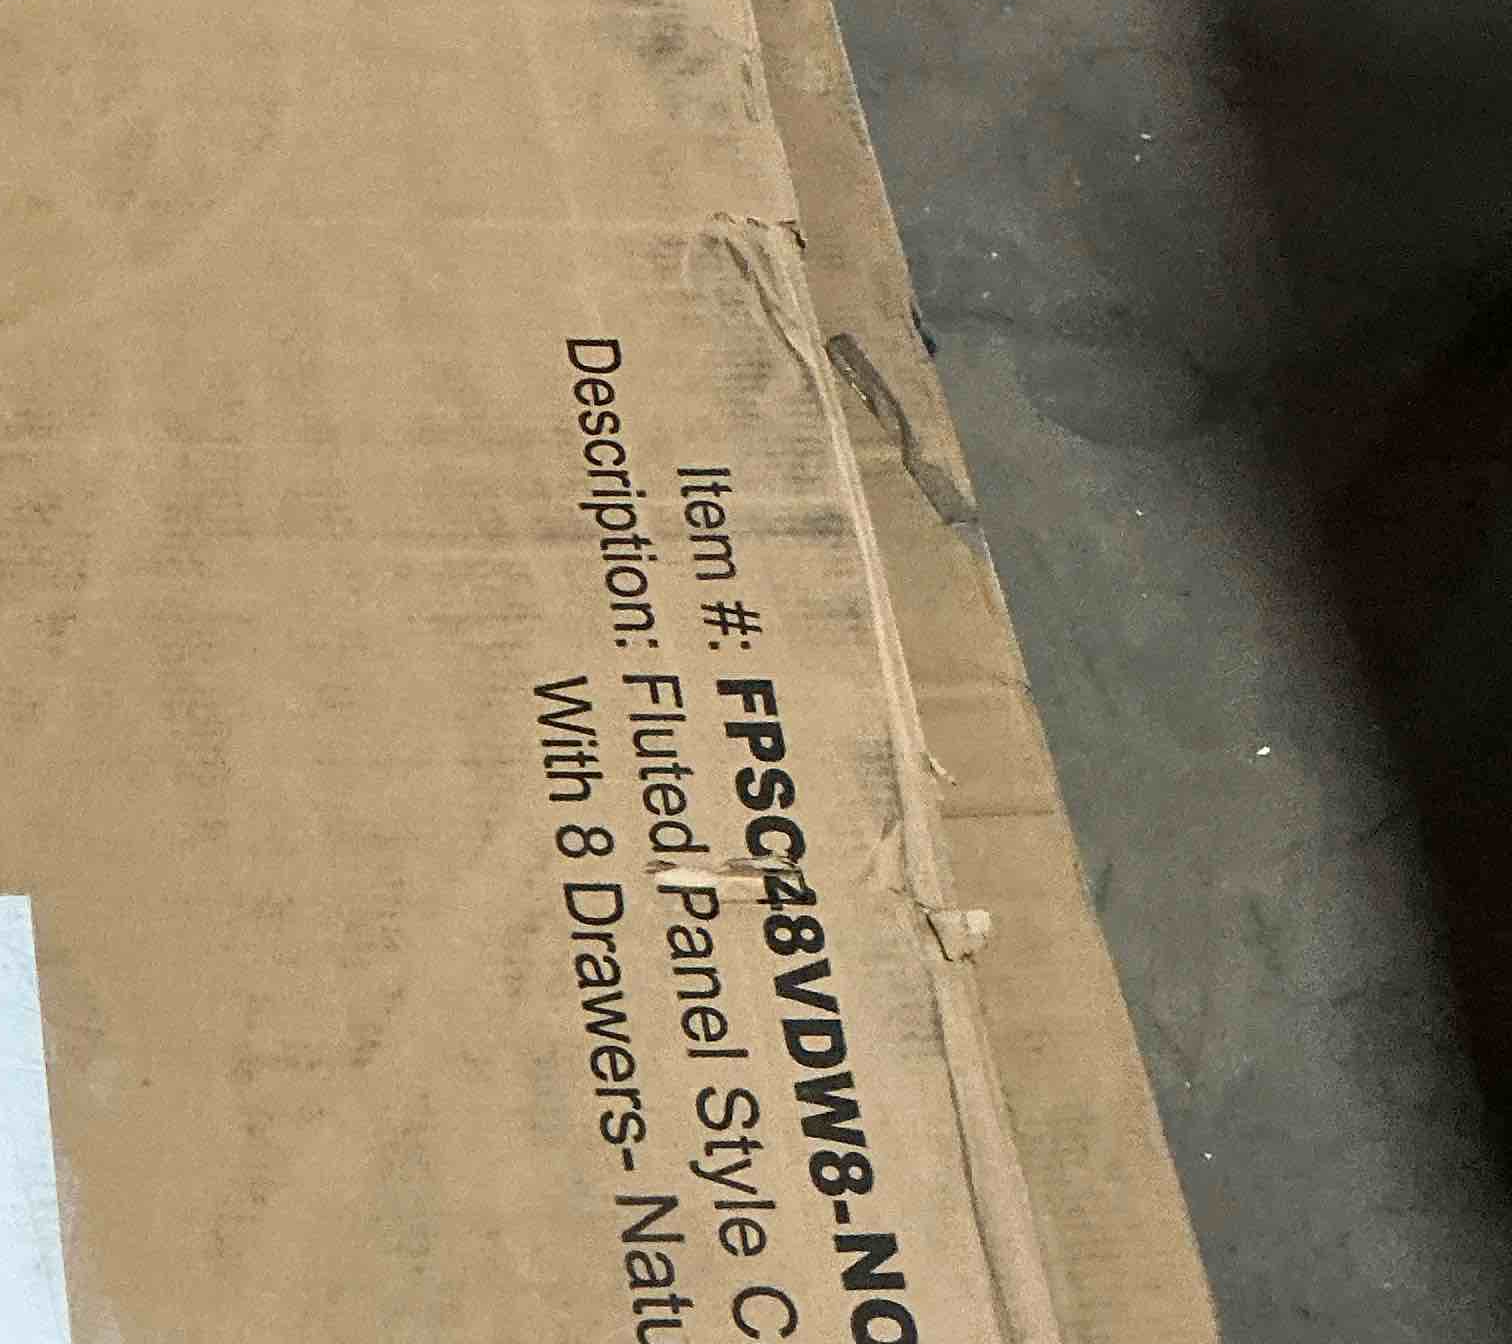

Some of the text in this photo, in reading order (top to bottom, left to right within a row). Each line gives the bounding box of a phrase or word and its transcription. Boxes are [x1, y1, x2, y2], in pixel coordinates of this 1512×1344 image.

[566, 337, 658, 649] Description:
[677, 466, 737, 582] Item
[701, 600, 763, 651] #:
[533, 675, 603, 803] With
[622, 673, 710, 854] Fluted
[555, 823, 615, 859] 8
[563, 882, 646, 1173] Drawers-
[656, 884, 748, 1059] Panel
[690, 1085, 775, 1258] Style
